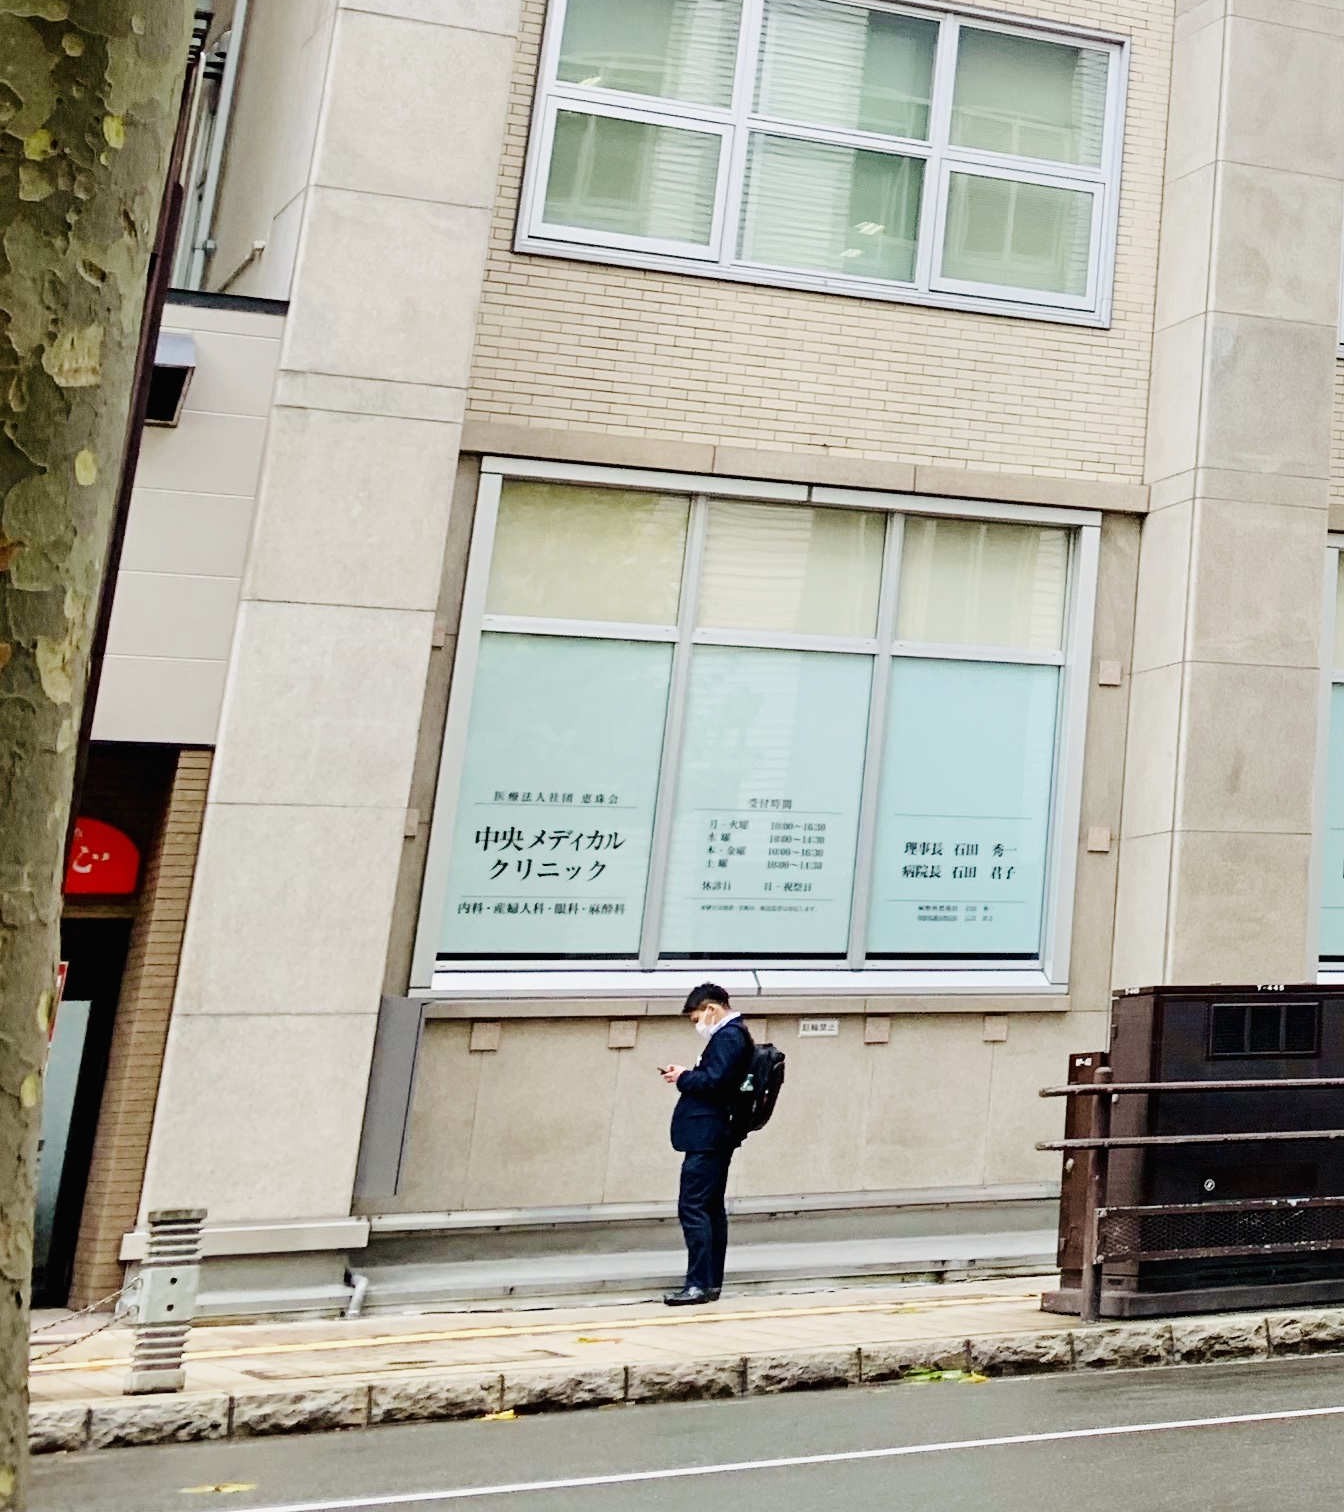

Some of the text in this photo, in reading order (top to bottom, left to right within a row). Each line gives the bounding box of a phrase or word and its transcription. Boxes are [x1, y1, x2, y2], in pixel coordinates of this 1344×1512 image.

[494, 791, 573, 803] 医療法人社団
[749, 798, 793, 810] 受付時間
[474, 826, 627, 851] 中央メディカル
[904, 841, 943, 856] 理事長
[954, 843, 979, 856] 石田
[489, 859, 607, 881] クリニック
[952, 866, 977, 879] 石田
